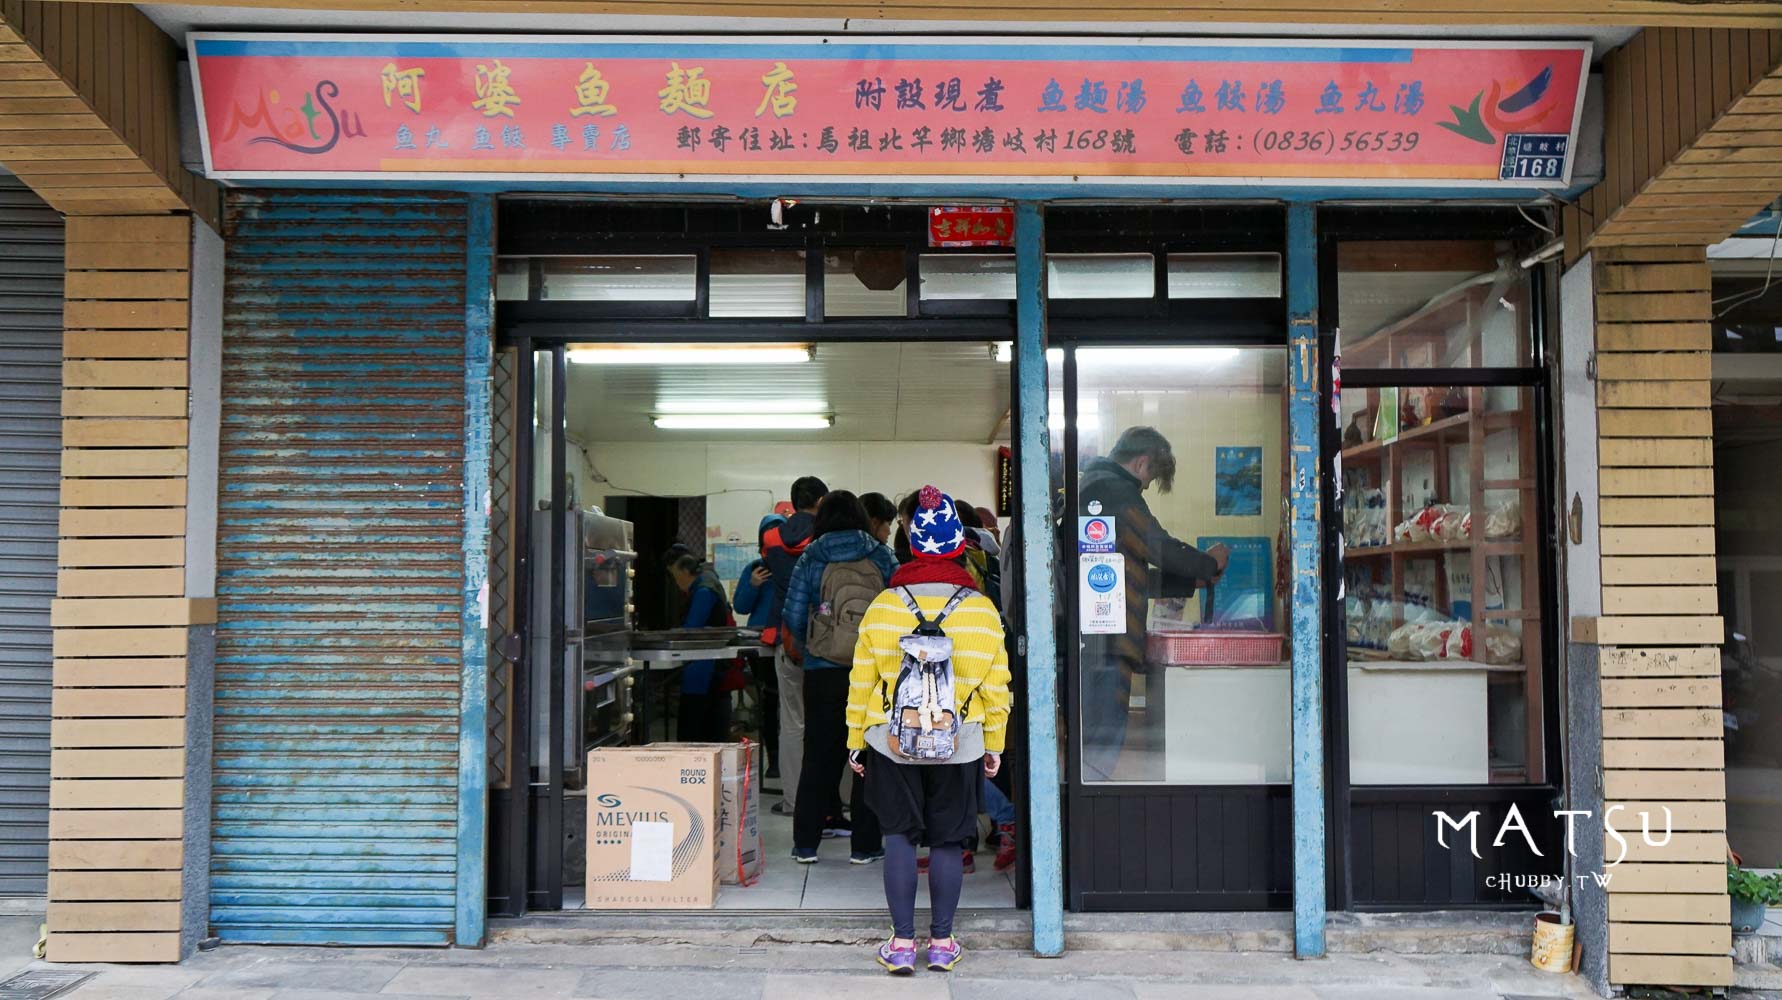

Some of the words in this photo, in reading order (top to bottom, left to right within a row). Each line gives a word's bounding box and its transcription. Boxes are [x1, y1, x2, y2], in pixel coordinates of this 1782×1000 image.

[380, 59, 801, 120] 阿婆魚麵店
[855, 76, 1006, 114] 附設現煮
[1037, 77, 1148, 114] 魚麵湯
[1175, 78, 1286, 114] 魚餃湯
[1314, 79, 1425, 116] 魚丸湯
[393, 124, 450, 151] 魚丸
[472, 124, 527, 151] 魚餃
[550, 124, 633, 152] 專賣店
[1519, 158, 1558, 177] 168
[680, 769, 707, 777] ROUND
[680, 777, 707, 785] BOX
[596, 830, 633, 838] ORIGIN
